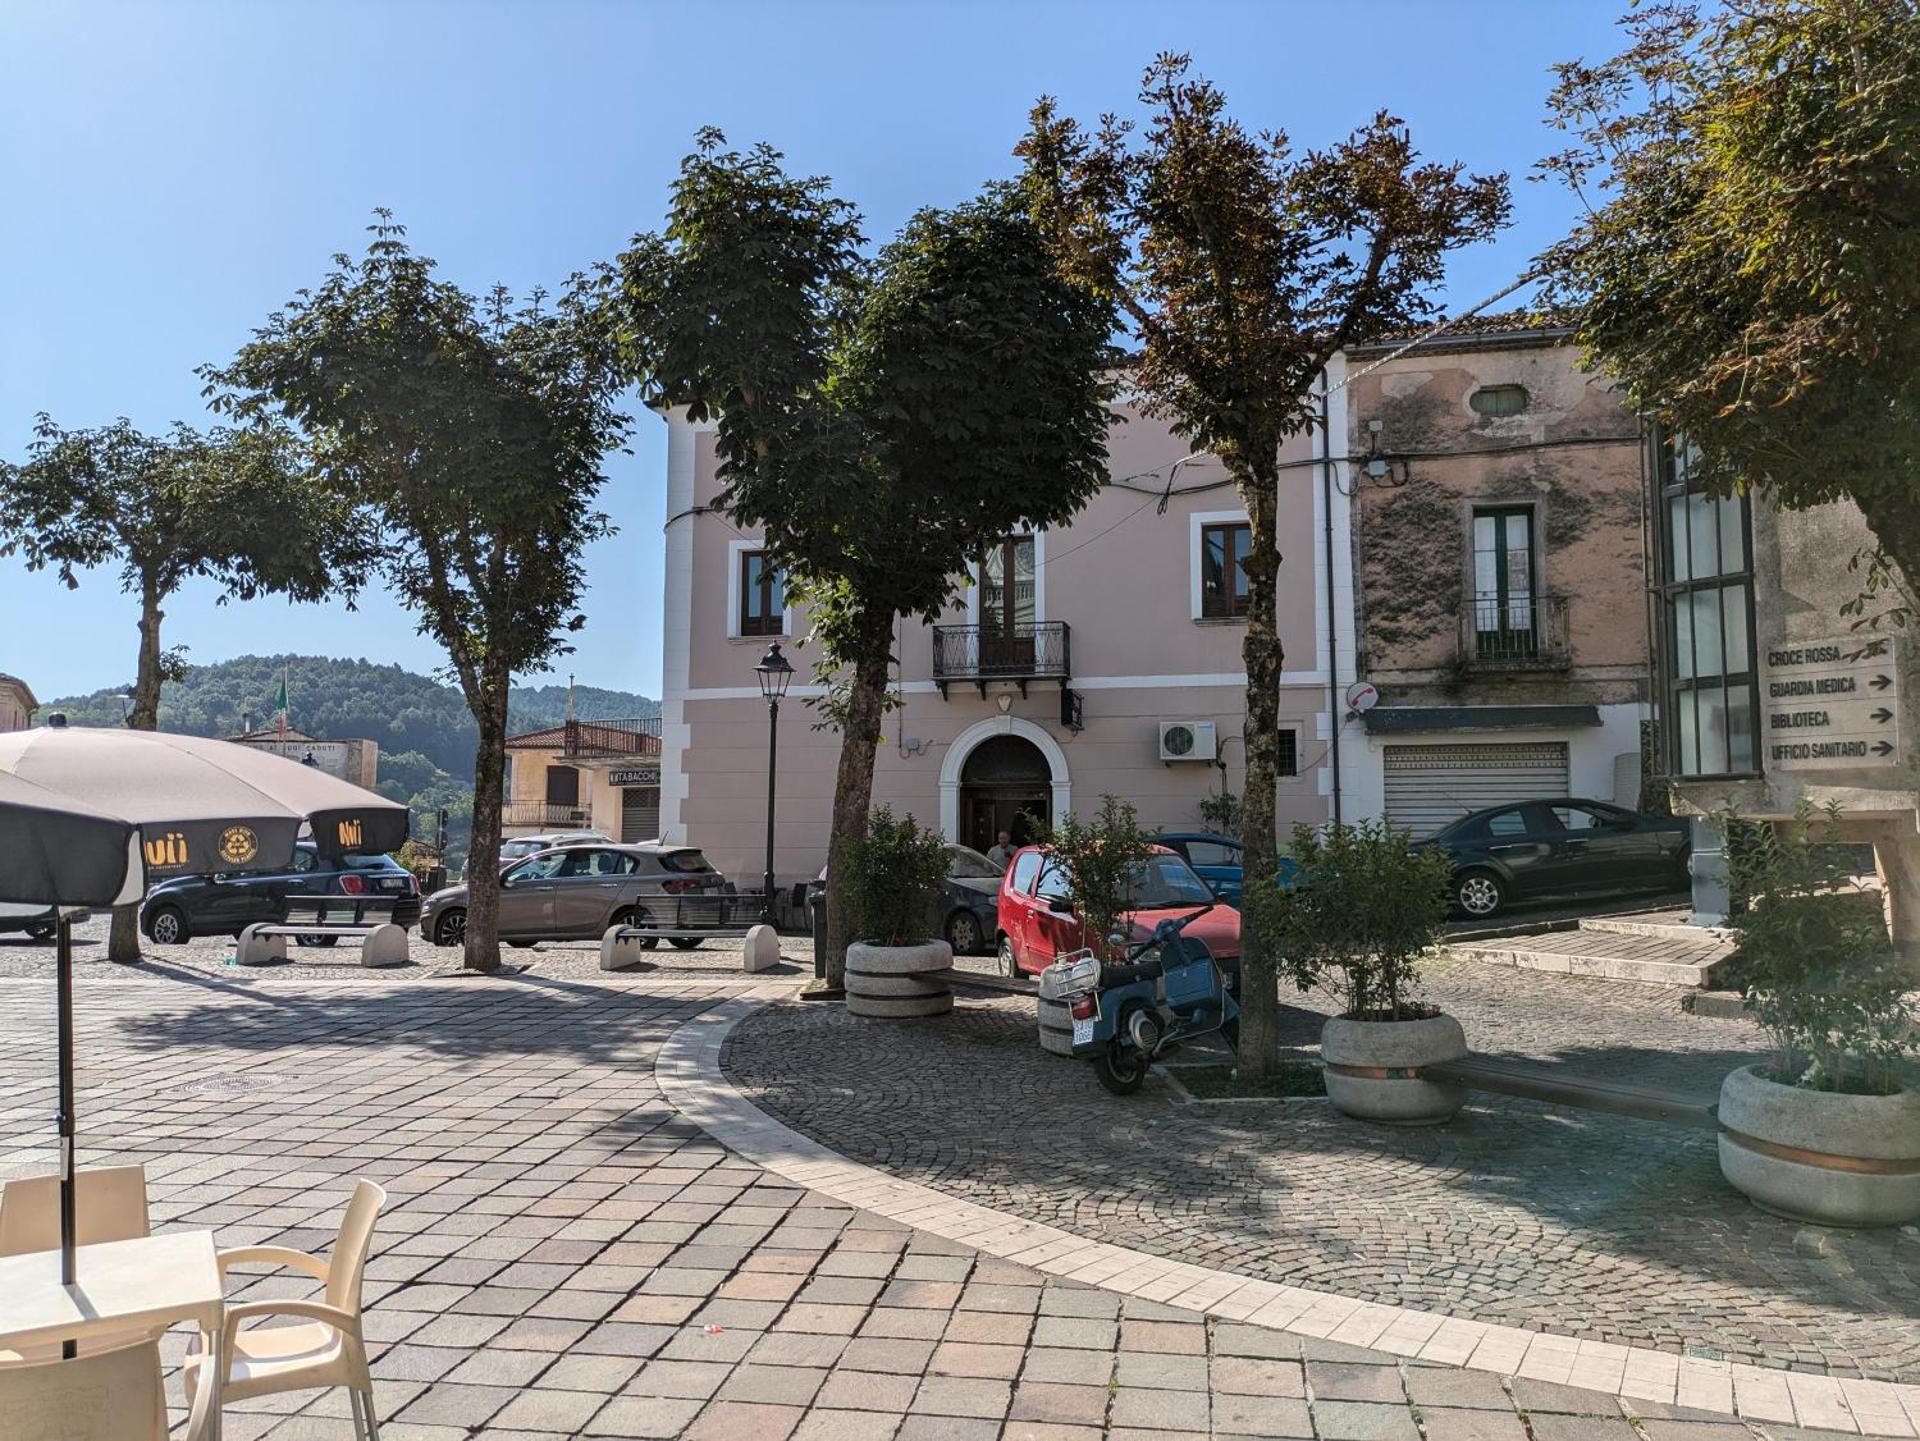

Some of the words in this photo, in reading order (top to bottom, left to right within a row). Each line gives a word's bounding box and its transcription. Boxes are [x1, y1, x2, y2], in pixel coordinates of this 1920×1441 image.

[1768, 650, 1803, 667] CROCE
[1805, 646, 1841, 664] ROSSA
[1769, 680, 1815, 698] GUARDIA
[1816, 677, 1856, 695] MEDICA
[1770, 711, 1830, 729] BIBLIOTECA
[1772, 744, 1810, 760] UFFICIO
[1811, 741, 1867, 758] SANITARIO
